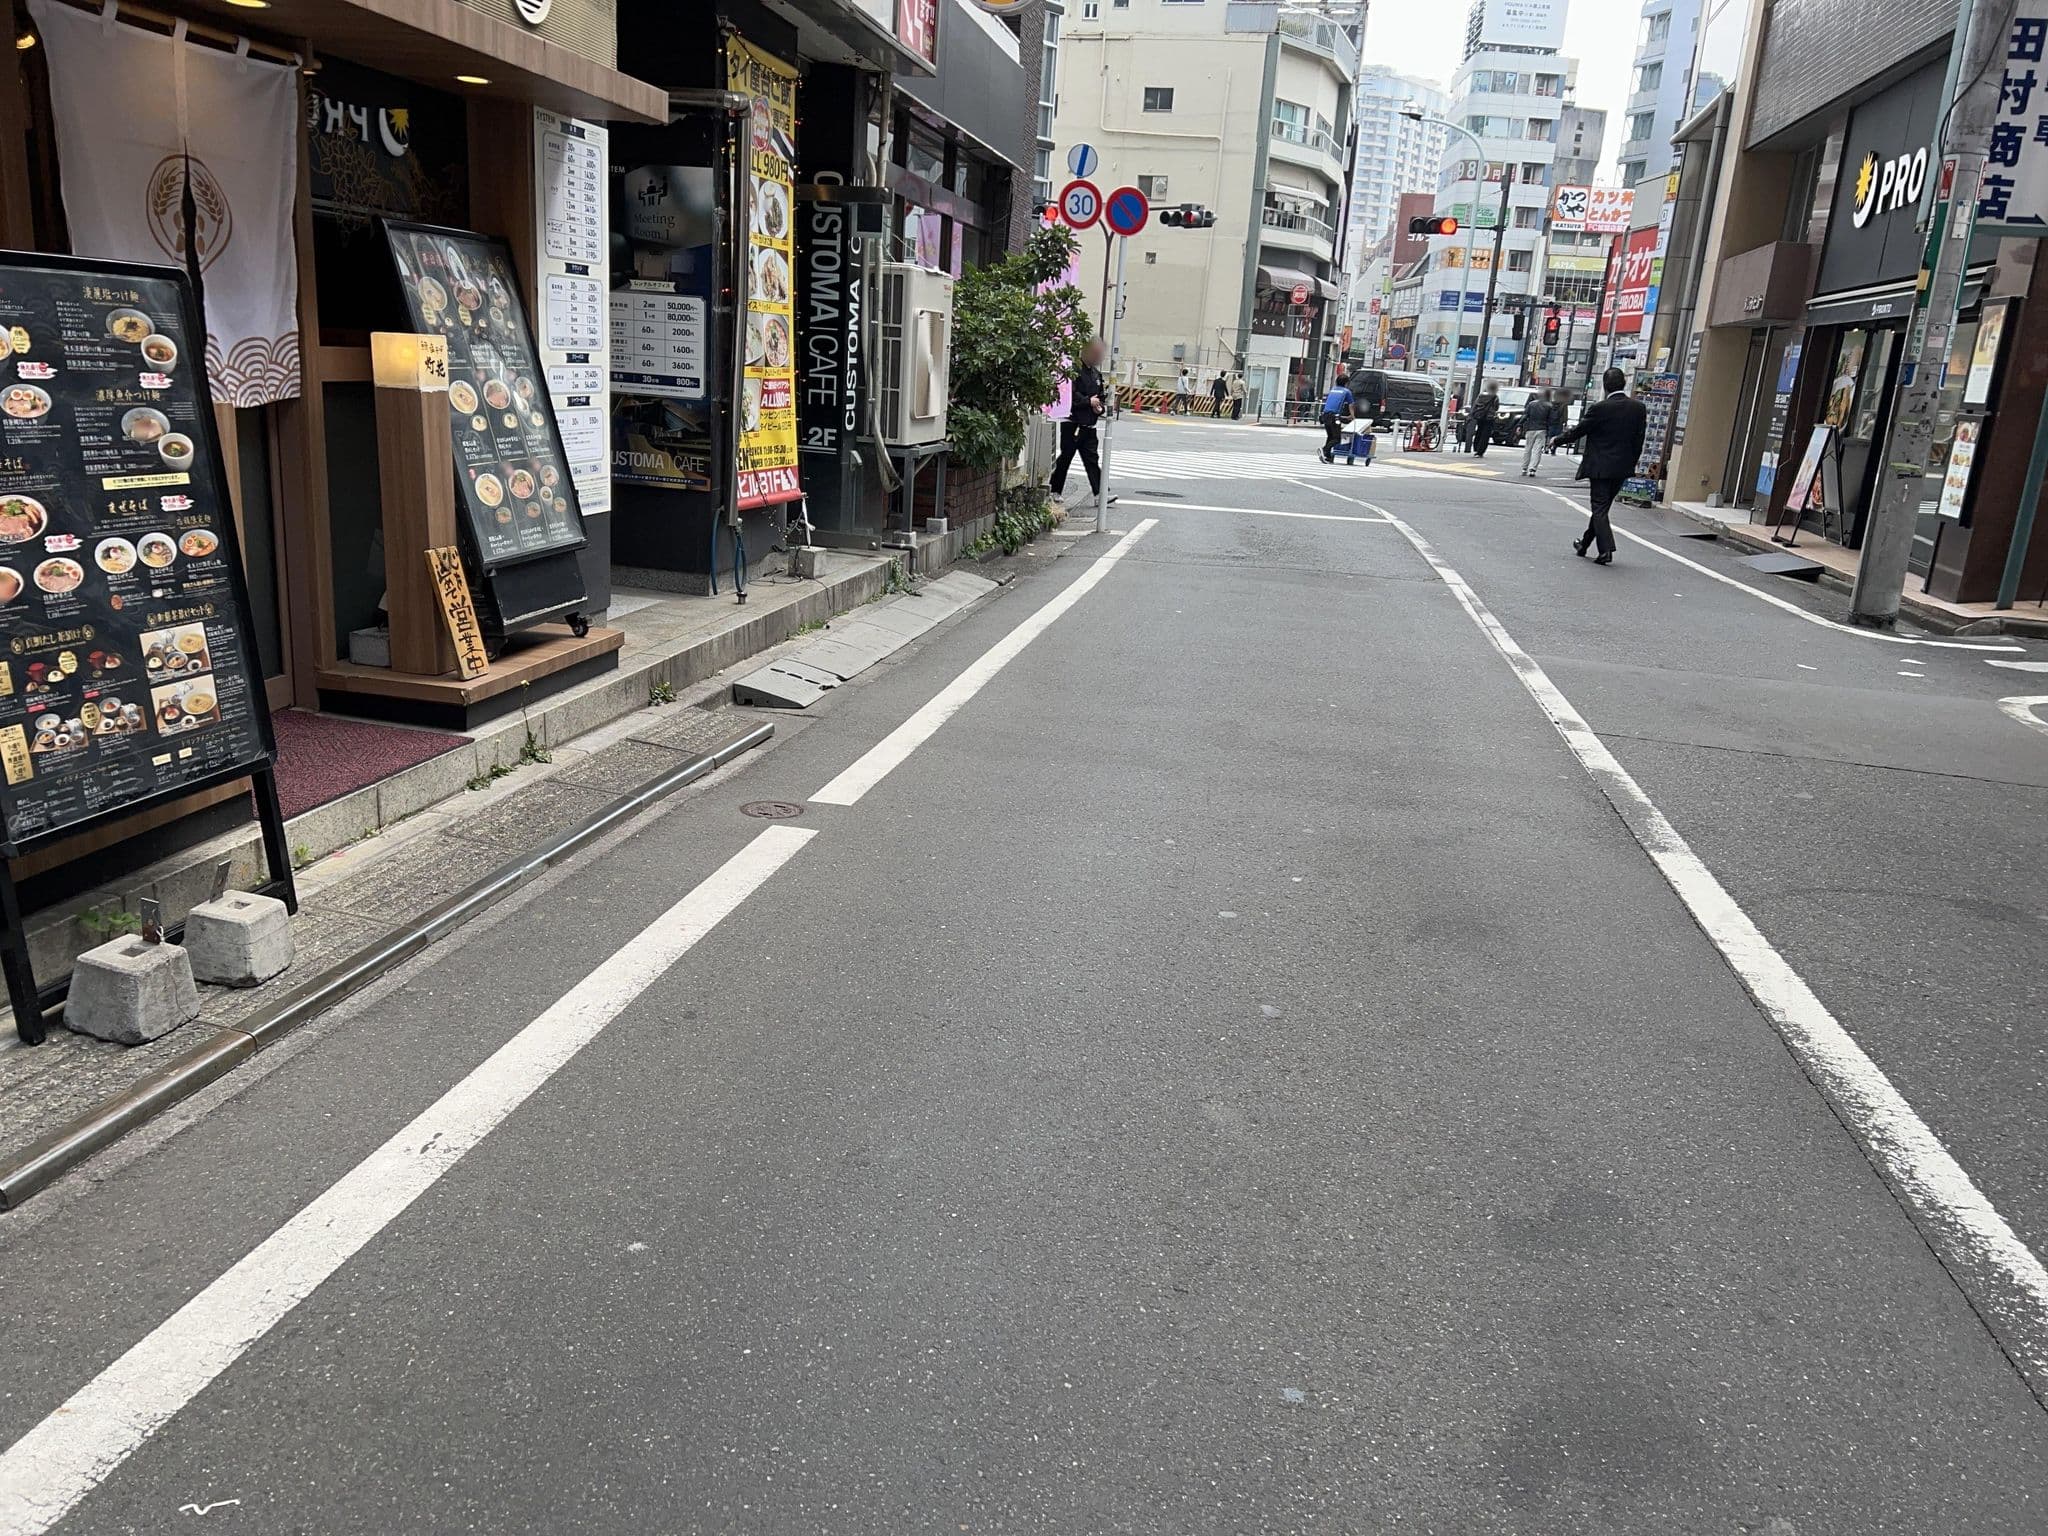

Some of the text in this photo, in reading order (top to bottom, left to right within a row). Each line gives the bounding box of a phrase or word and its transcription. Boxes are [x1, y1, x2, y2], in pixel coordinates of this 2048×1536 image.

[1875, 147, 1927, 215] PRO
[1069, 193, 1093, 216] 30
[808, 334, 840, 407] CAFE
[844, 278, 861, 432] CUSTOMA
[808, 428, 838, 447] 2F
[673, 455, 705, 473] CAFE
